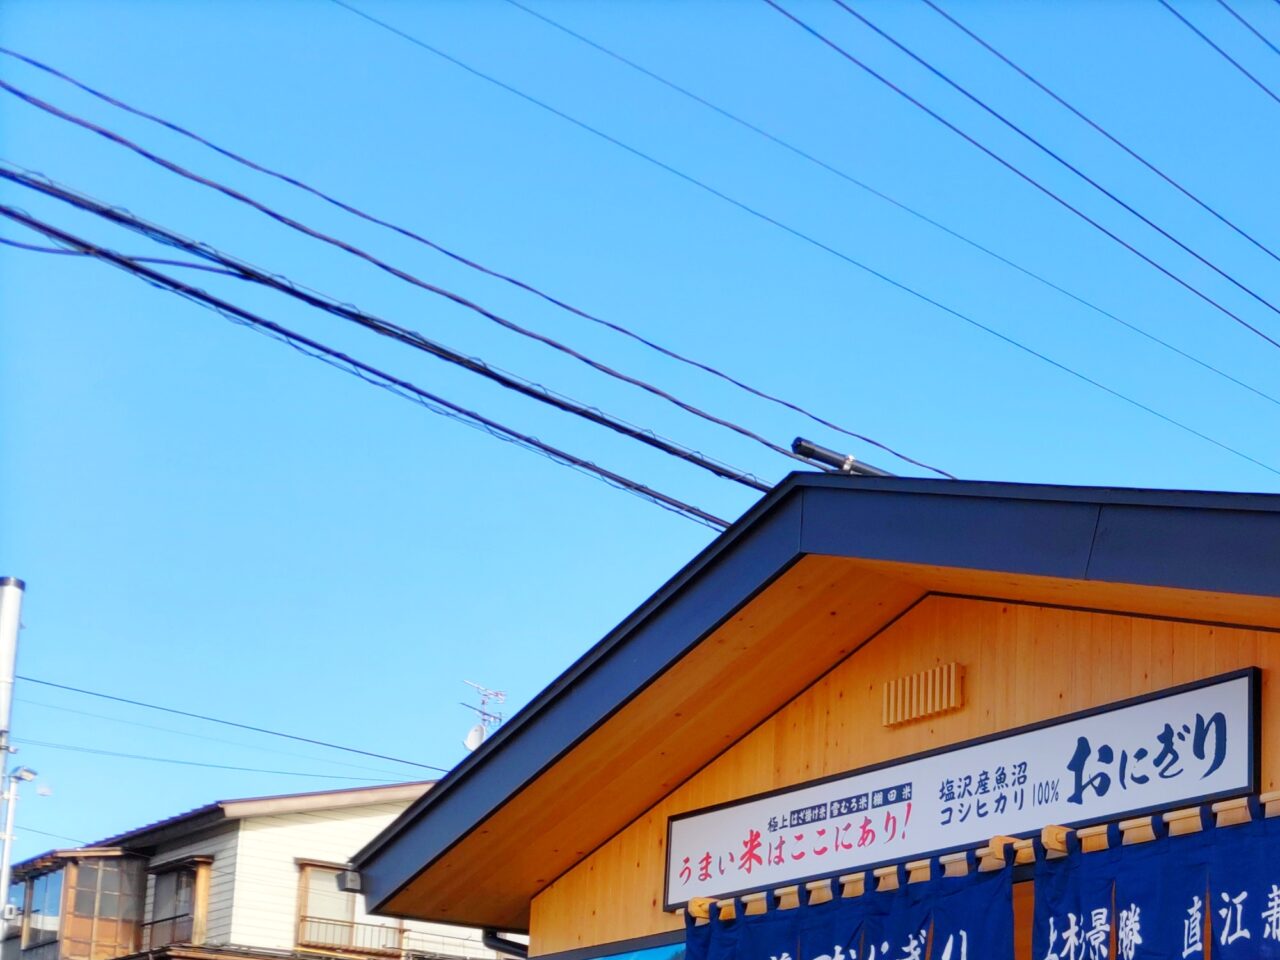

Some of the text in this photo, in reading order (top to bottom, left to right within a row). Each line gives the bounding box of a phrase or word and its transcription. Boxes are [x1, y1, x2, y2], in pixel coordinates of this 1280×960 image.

[939, 761, 1028, 802] 塩沢産魚沼
[1066, 711, 1227, 805] おにぎり
[940, 778, 1060, 826] コシヒカリ 100%
